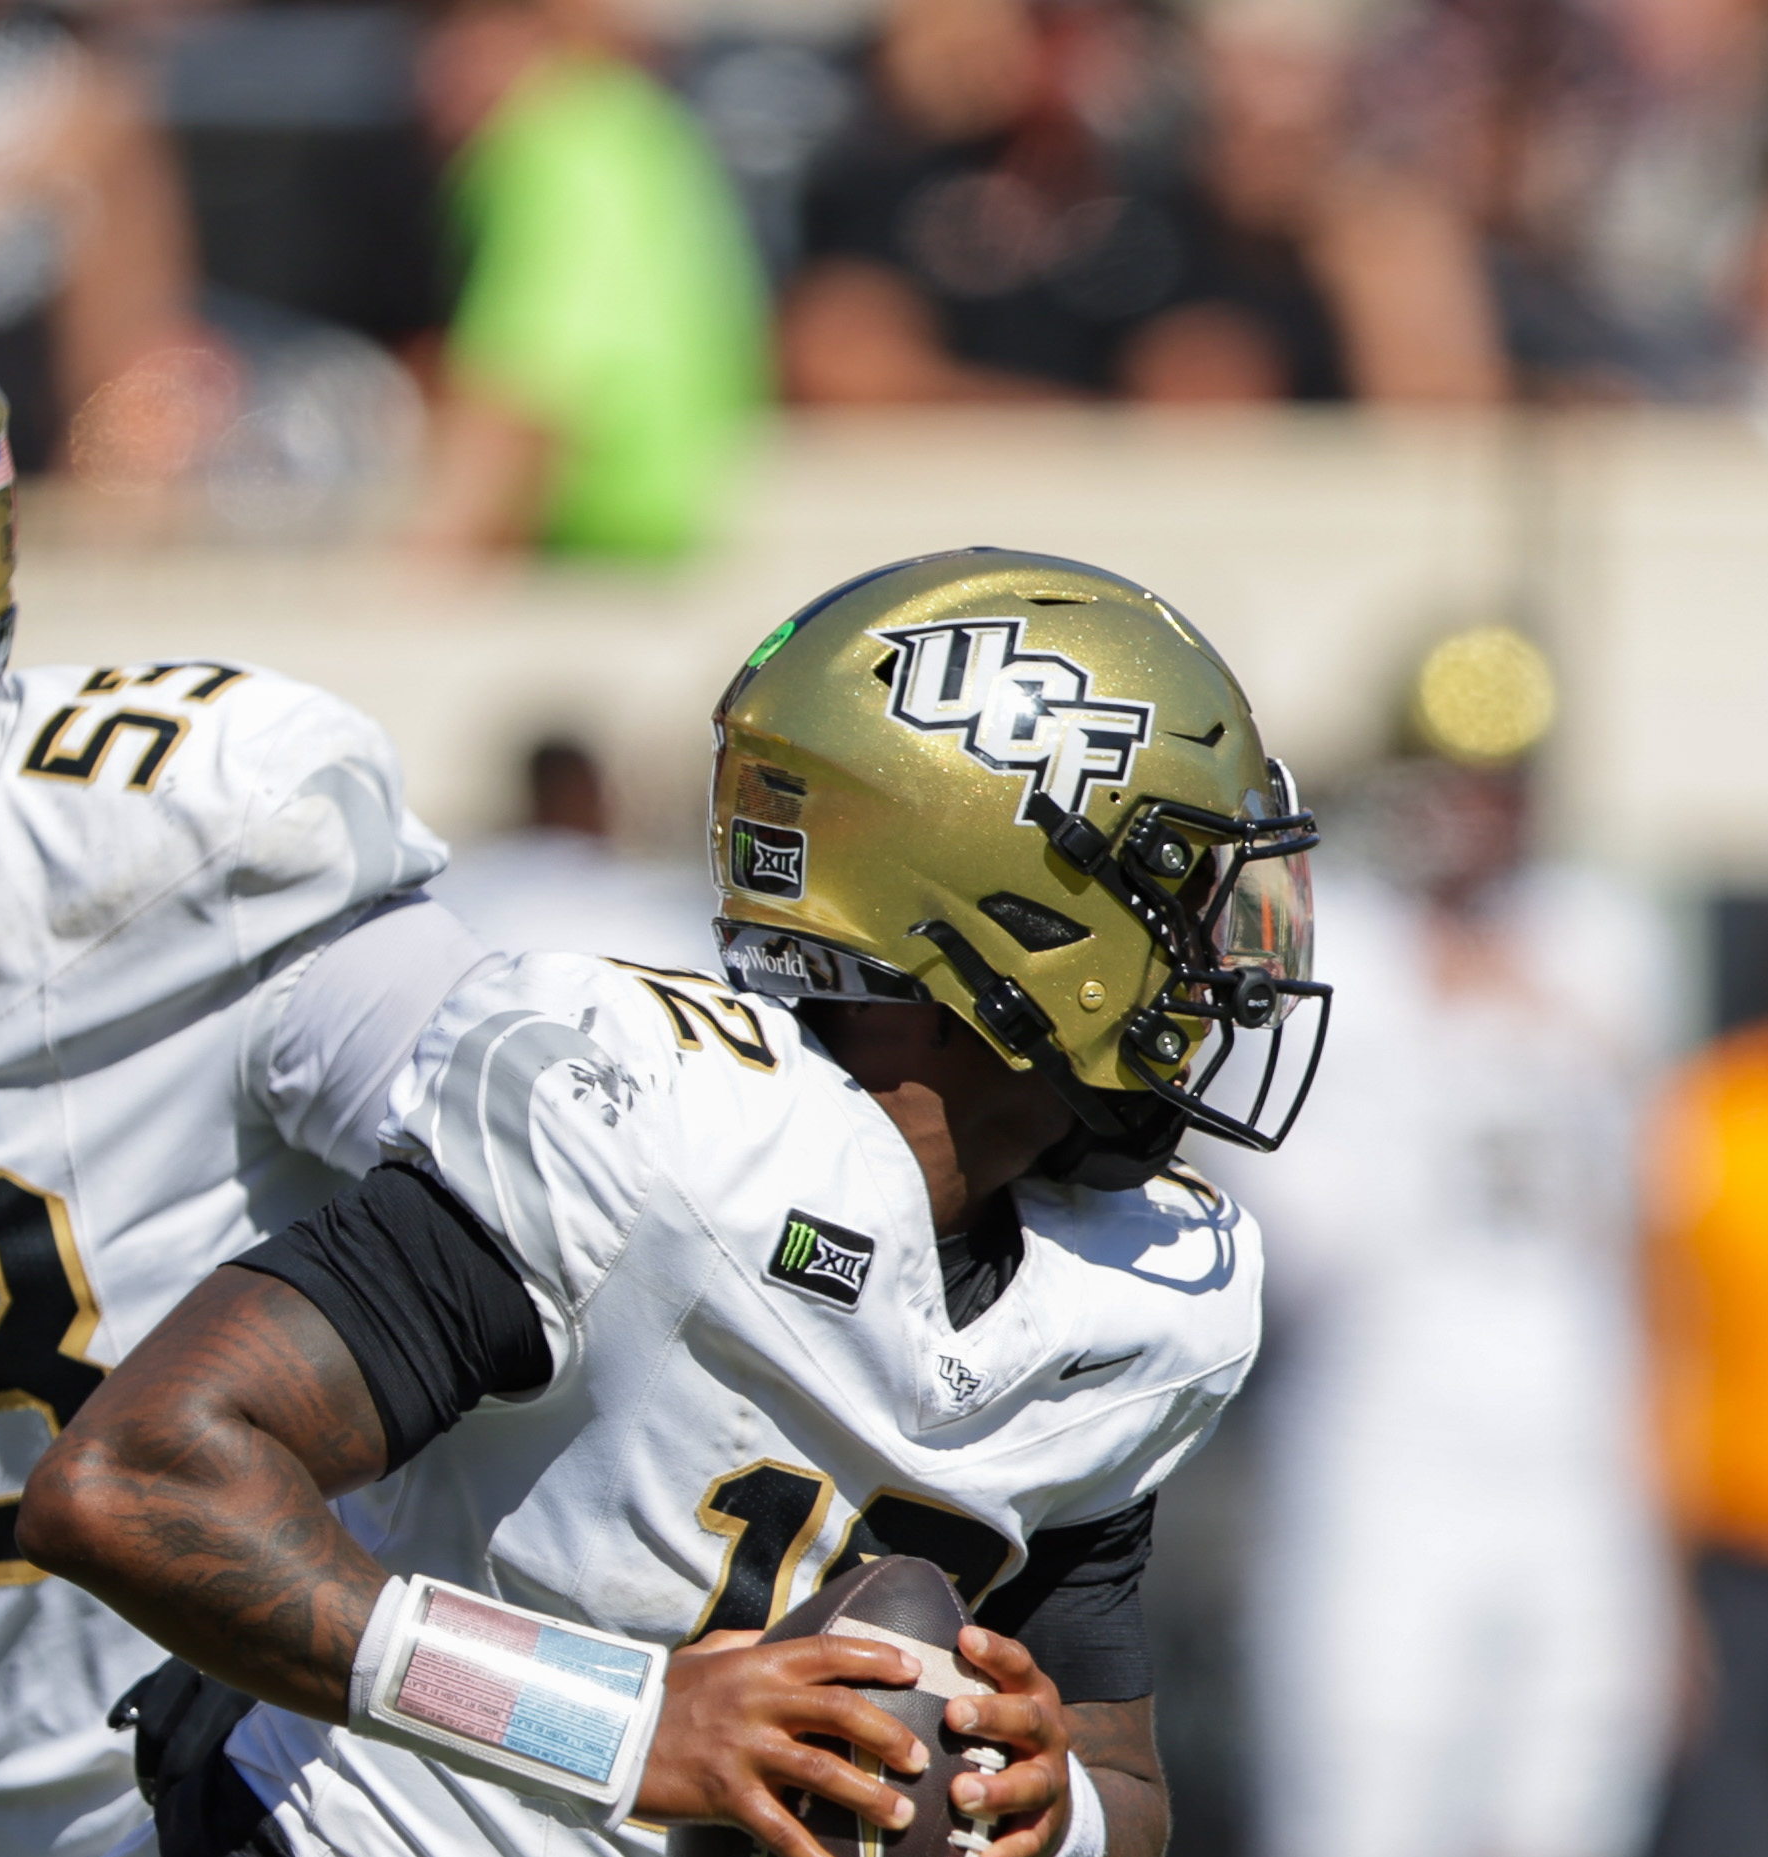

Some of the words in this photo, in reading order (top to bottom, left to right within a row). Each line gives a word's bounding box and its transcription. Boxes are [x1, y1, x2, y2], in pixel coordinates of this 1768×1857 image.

[863, 617, 1155, 826] UCF
[745, 946, 804, 977] World
[937, 1354, 981, 1401] UCF
[405, 1677, 428, 1692] SLAY
[439, 1689, 464, 1705] PUSH
[463, 1698, 476, 1709] RT
[476, 1702, 500, 1717] WING
[509, 1715, 534, 1730] SLAY
[544, 1727, 569, 1742] PUSH
[581, 1740, 605, 1755] WING
